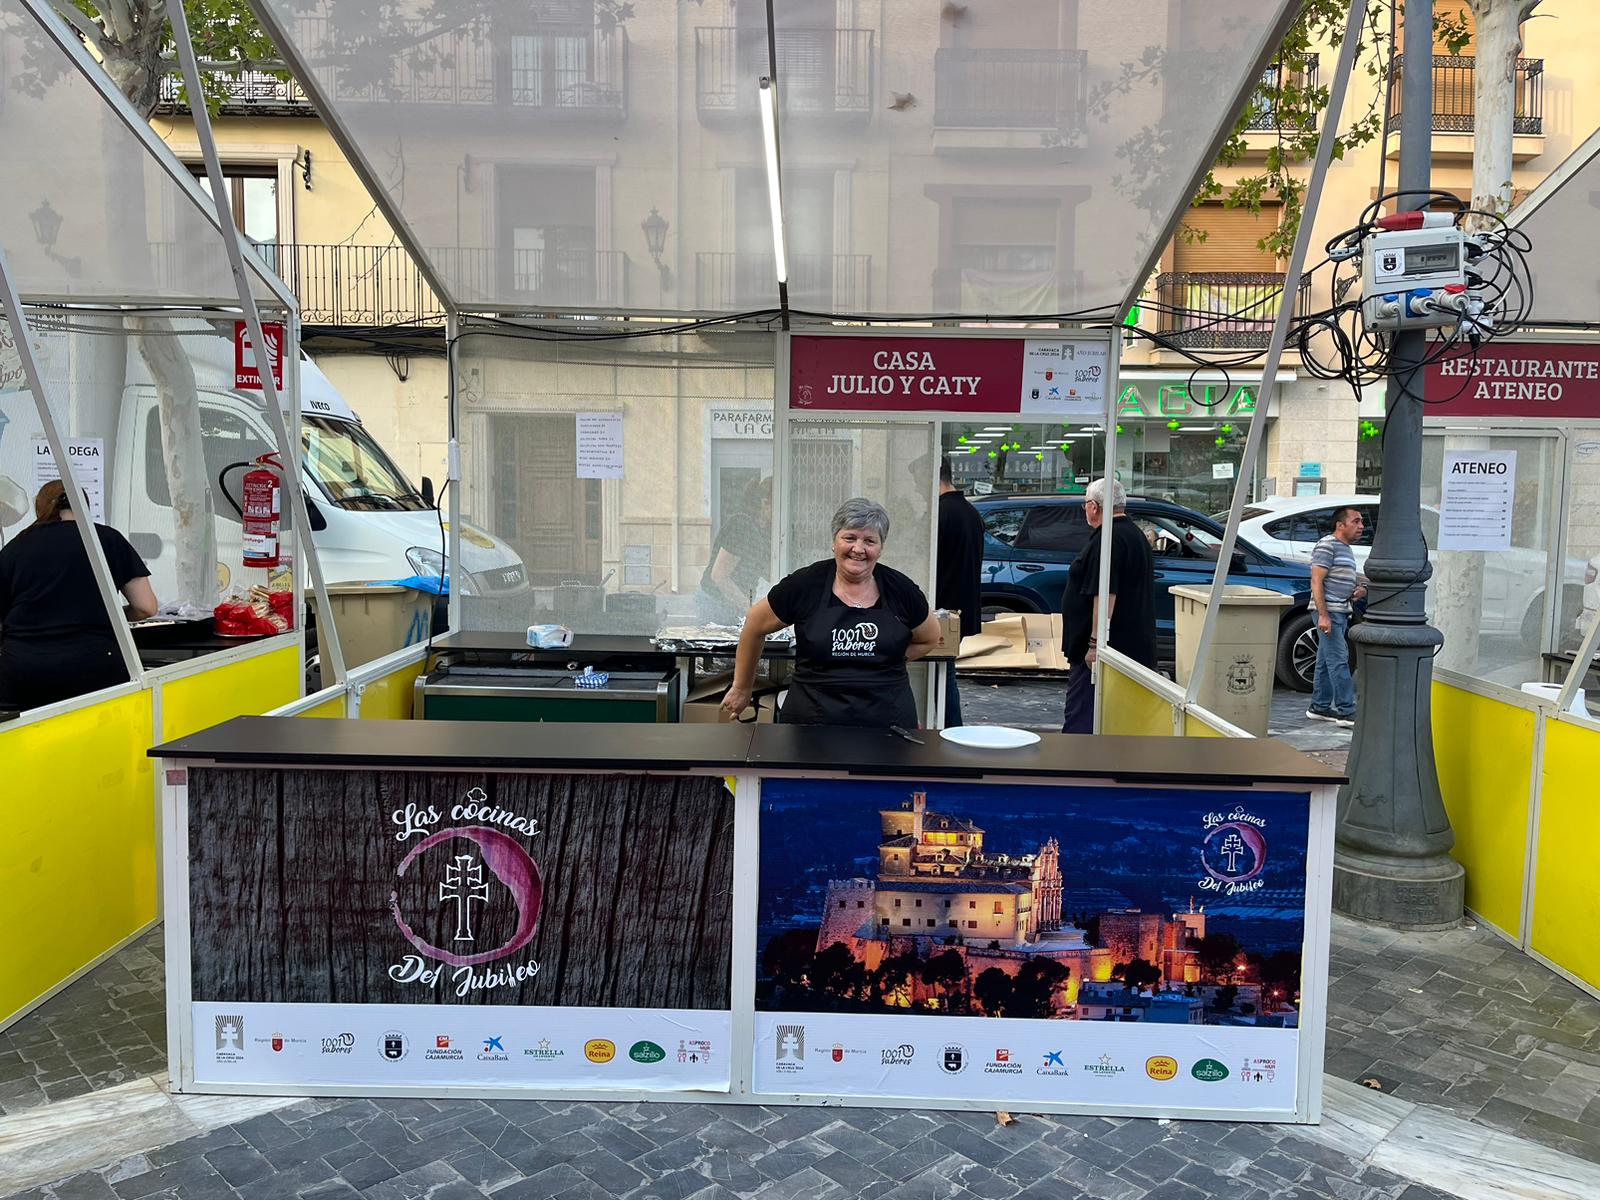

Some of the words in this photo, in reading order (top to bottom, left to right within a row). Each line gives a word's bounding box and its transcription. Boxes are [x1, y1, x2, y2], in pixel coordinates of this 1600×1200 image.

[873, 351, 936, 371] CASA
[1440, 358, 1599, 379] RESTAURANTE
[236, 374, 281, 385] EXTINR
[827, 375, 894, 394] JULIO
[900, 376, 915, 395] Y
[919, 376, 981, 396] CATY
[1474, 382, 1563, 401] ATENEO
[309, 400, 330, 411] IVECO
[1117, 384, 1257, 416] ACIA
[713, 412, 774, 423] PARAFARM
[37, 445, 50, 456] LA
[62, 446, 99, 457] DEGA
[1451, 462, 1507, 475] ATENEO
[831, 639, 876, 652] sabores
[392, 803, 442, 842] Las
[451, 801, 541, 837] cocinas
[1202, 812, 1225, 830] Las
[1227, 812, 1267, 828] cocinas
[1198, 876, 1222, 892] Del
[1224, 879, 1265, 896] Jubileo
[388, 954, 444, 989] Del
[451, 959, 541, 998] Jubileo
[321, 1045, 353, 1054] sabores
[588, 1050, 611, 1058] Reina
[476, 1053, 510, 1061] CaixaBank
[1036, 1068, 1069, 1077] CaixaBank
[1149, 1067, 1173, 1075] Reina
